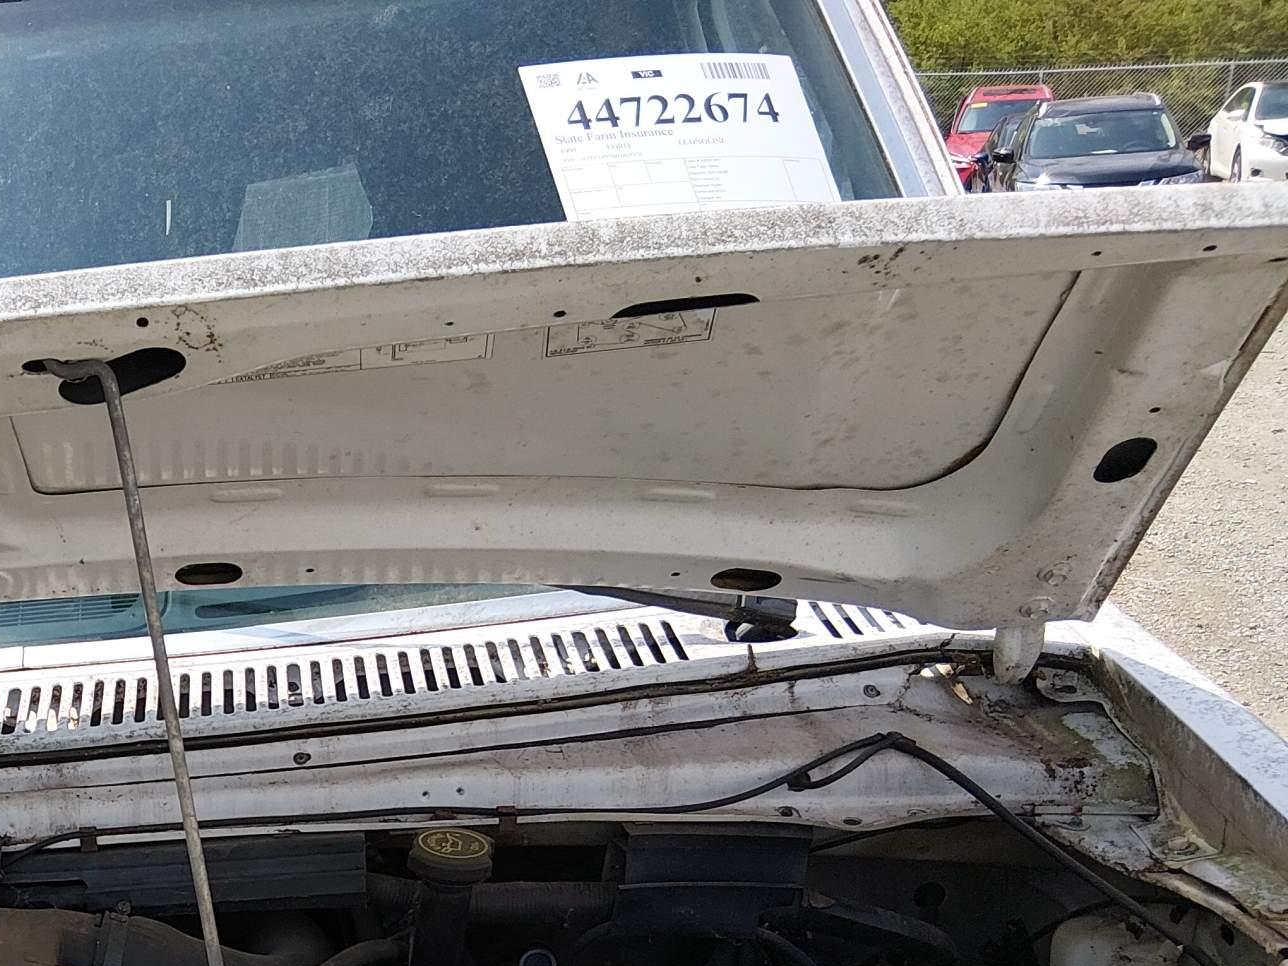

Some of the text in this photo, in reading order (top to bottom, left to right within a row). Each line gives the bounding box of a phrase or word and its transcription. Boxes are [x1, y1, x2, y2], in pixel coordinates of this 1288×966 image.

[567, 92, 780, 130] 44722674
[554, 128, 674, 145] State Farm Insurance
